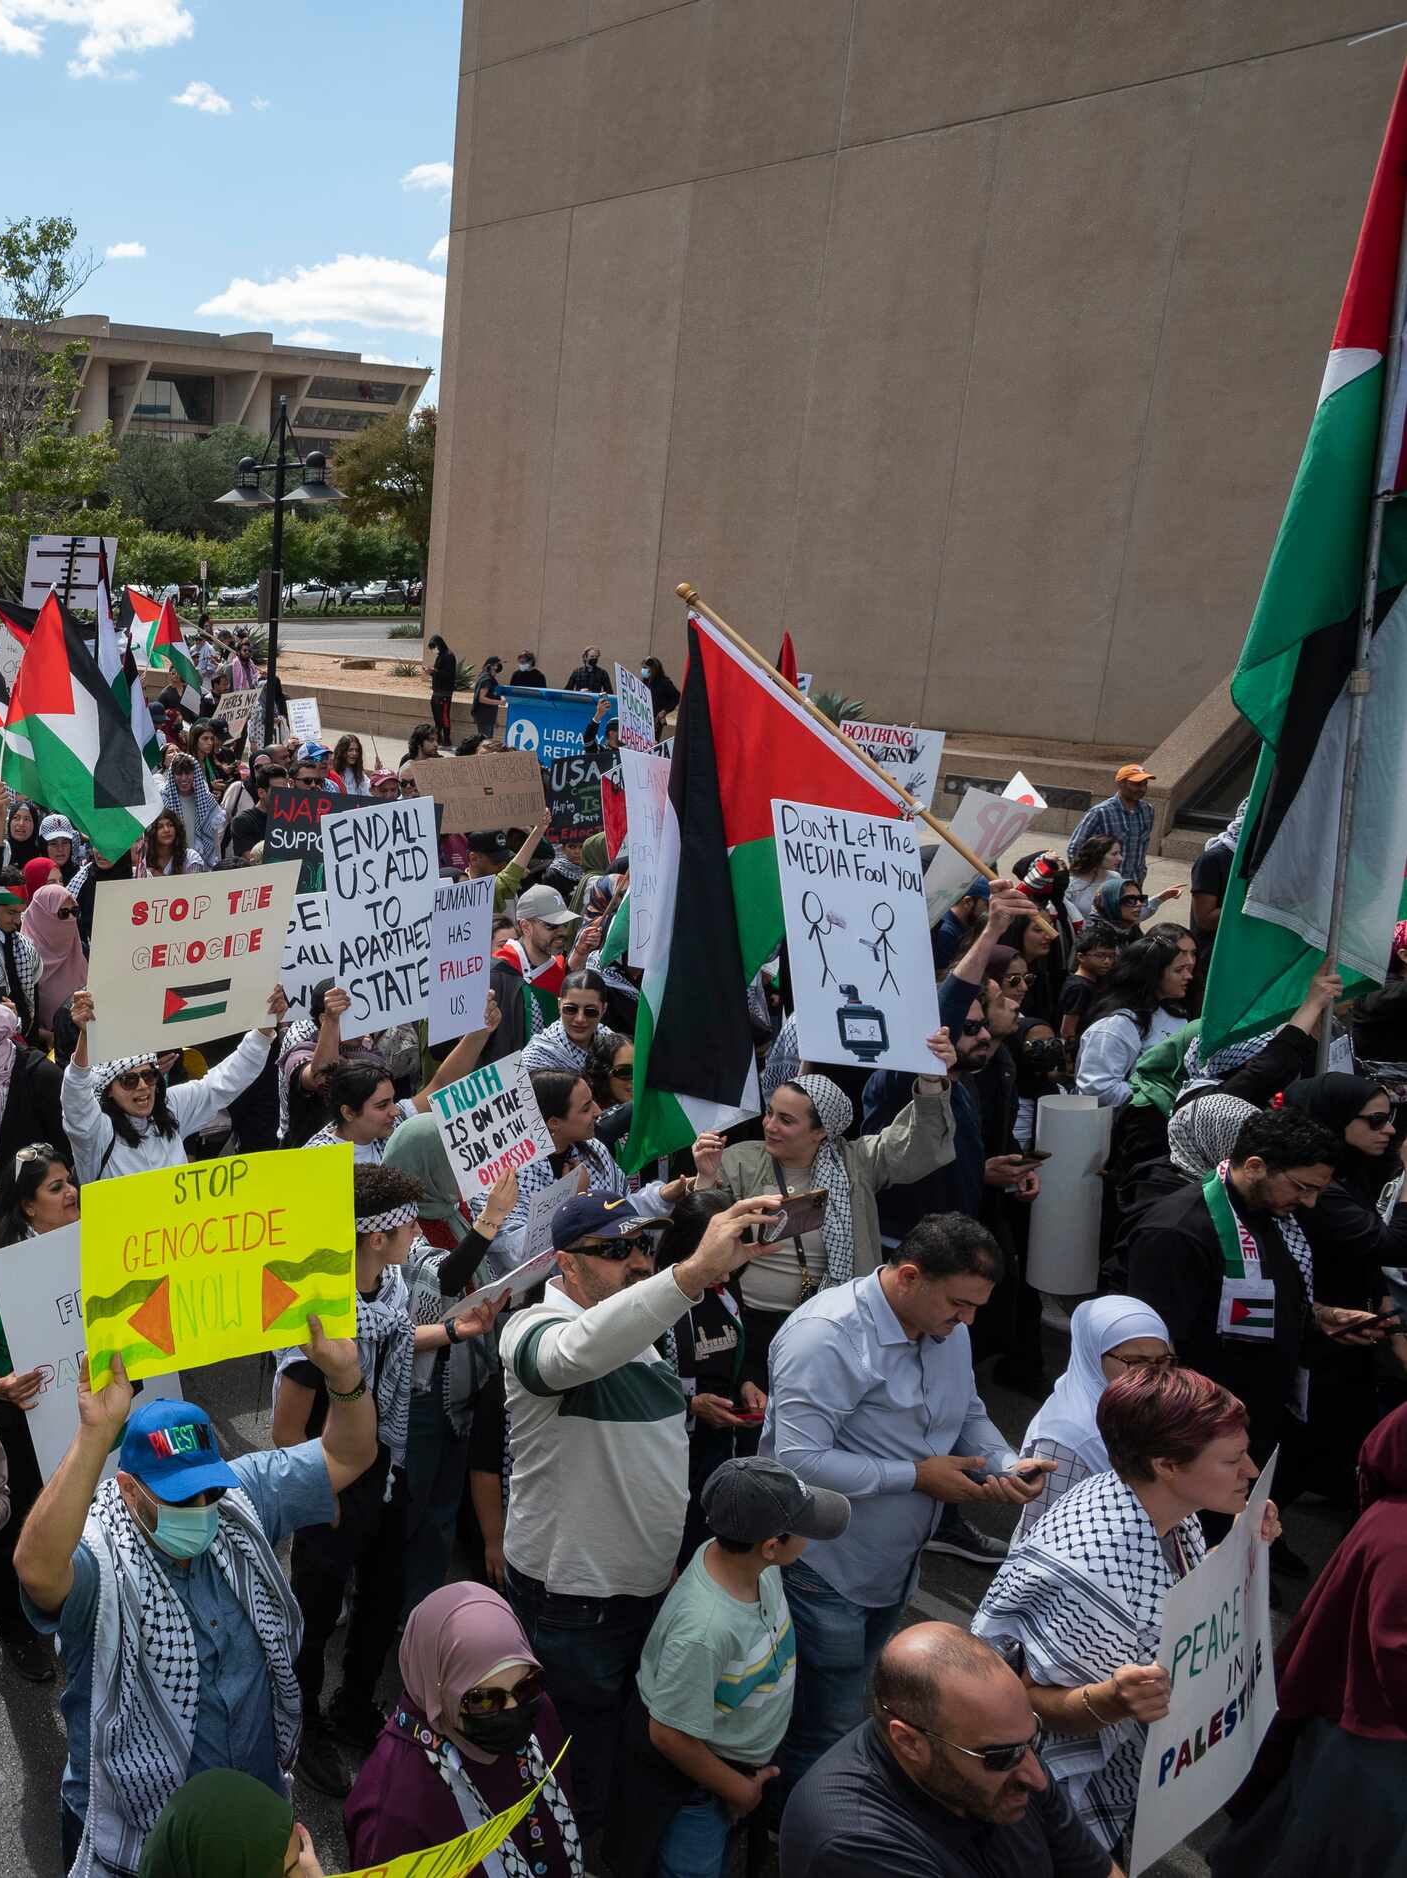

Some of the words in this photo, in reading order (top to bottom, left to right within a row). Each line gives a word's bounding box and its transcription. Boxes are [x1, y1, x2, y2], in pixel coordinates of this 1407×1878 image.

[543, 727, 606, 746] LIBRAY
[842, 723, 913, 748] BOMBING
[551, 759, 602, 792] USA
[270, 829, 324, 852] SUPPO
[844, 817, 878, 848] Let
[879, 825, 916, 857] The
[385, 846, 429, 885] AID
[783, 840, 851, 879] MEDIA
[854, 853, 888, 886] Fool
[131, 895, 211, 926] STOP
[228, 885, 274, 916] THE
[364, 896, 402, 930] TO
[434, 879, 494, 913] HUMANITY
[132, 927, 264, 972] GENOCIDE
[339, 912, 434, 977] APARTHEI
[448, 921, 471, 944] HAS
[349, 956, 430, 1021] STATE
[440, 956, 484, 982] FAILED
[444, 1118, 469, 1150] IS
[471, 1103, 494, 1133] ON
[492, 1087, 524, 1120] THE
[458, 1135, 493, 1172] SIDE
[492, 1127, 509, 1149] OF
[508, 1114, 529, 1139] THE
[174, 1159, 248, 1205] STOP
[123, 1208, 287, 1272] GENOCIDE
[176, 1270, 243, 1341] NOW
[1170, 1585, 1242, 1689] PEACE
[1227, 1648, 1244, 1695] IN
[1157, 1639, 1263, 1789] PALESTINE
